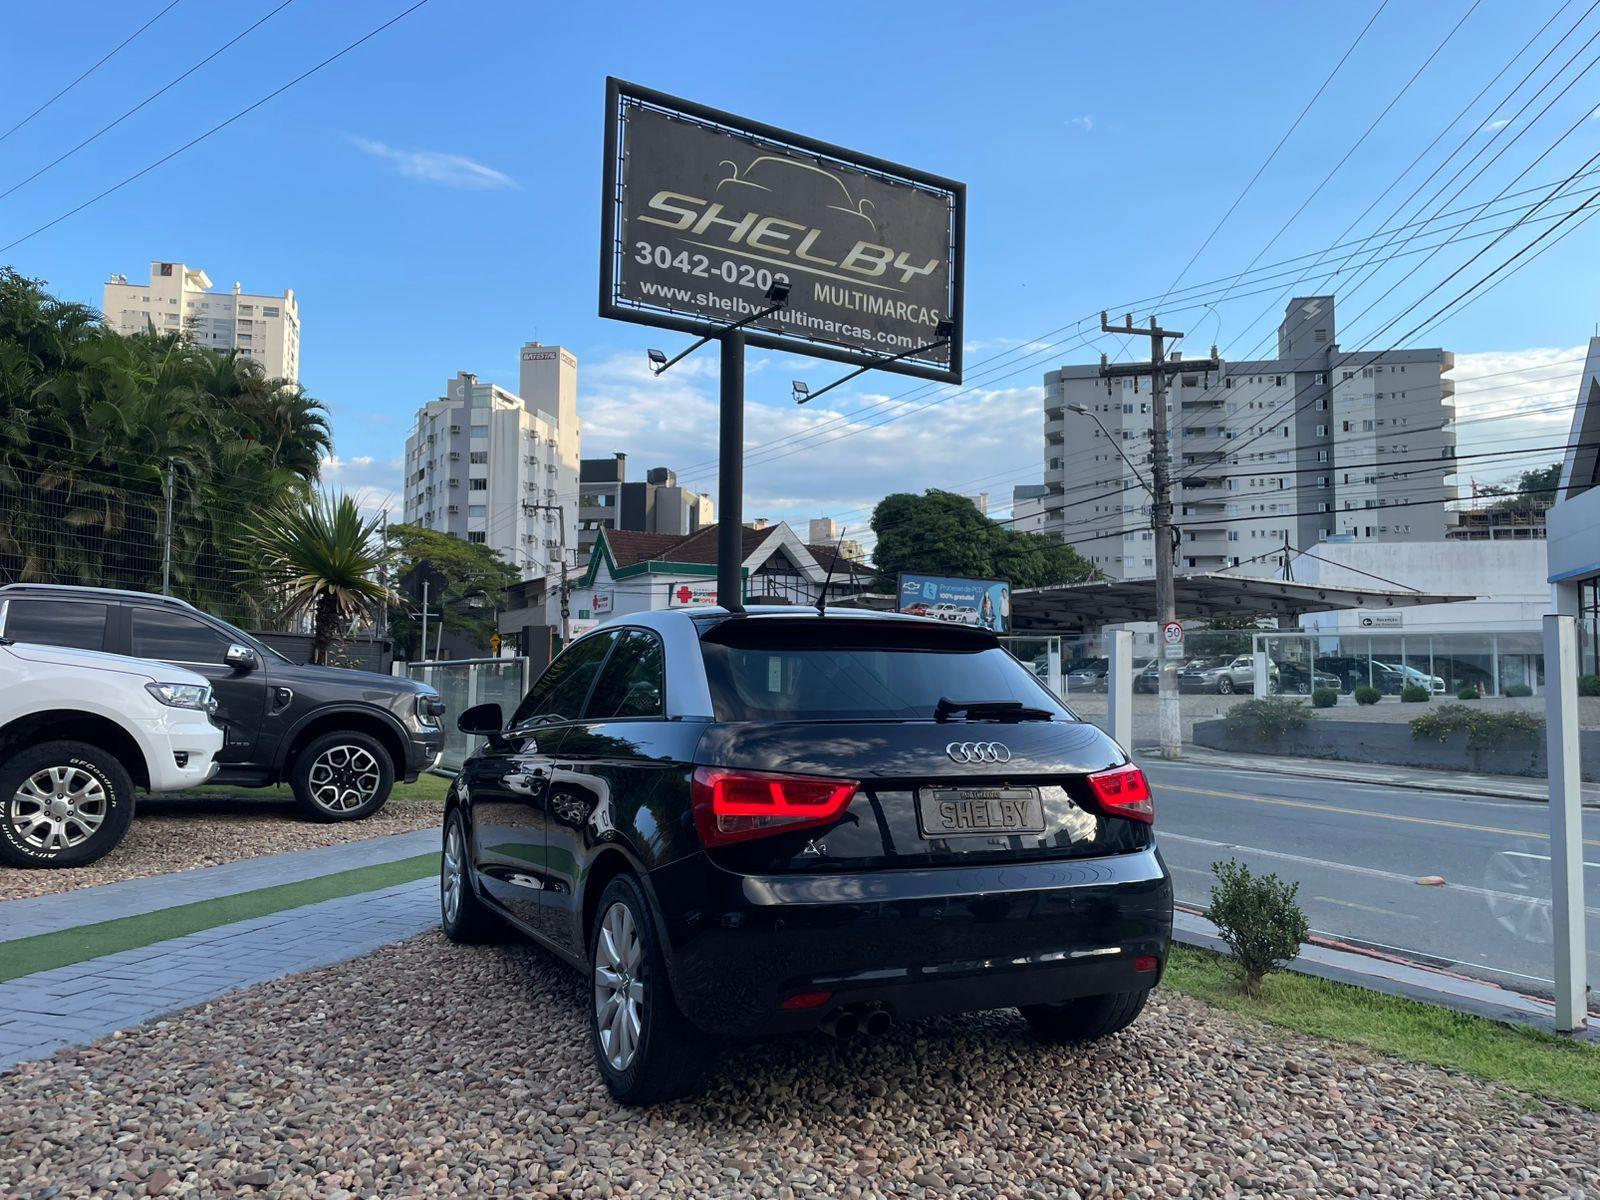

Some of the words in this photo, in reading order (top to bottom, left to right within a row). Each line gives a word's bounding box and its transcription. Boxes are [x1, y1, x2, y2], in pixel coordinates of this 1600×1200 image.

[637, 191, 939, 283] SHELBY
[814, 282, 939, 327] MULTIMARCAS
[1167, 628, 1180, 637] 50
[70, 758, 117, 808] BFGoodrich
[940, 801, 1029, 829] SHELBY
[2, 824, 57, 858] All-Terrain
